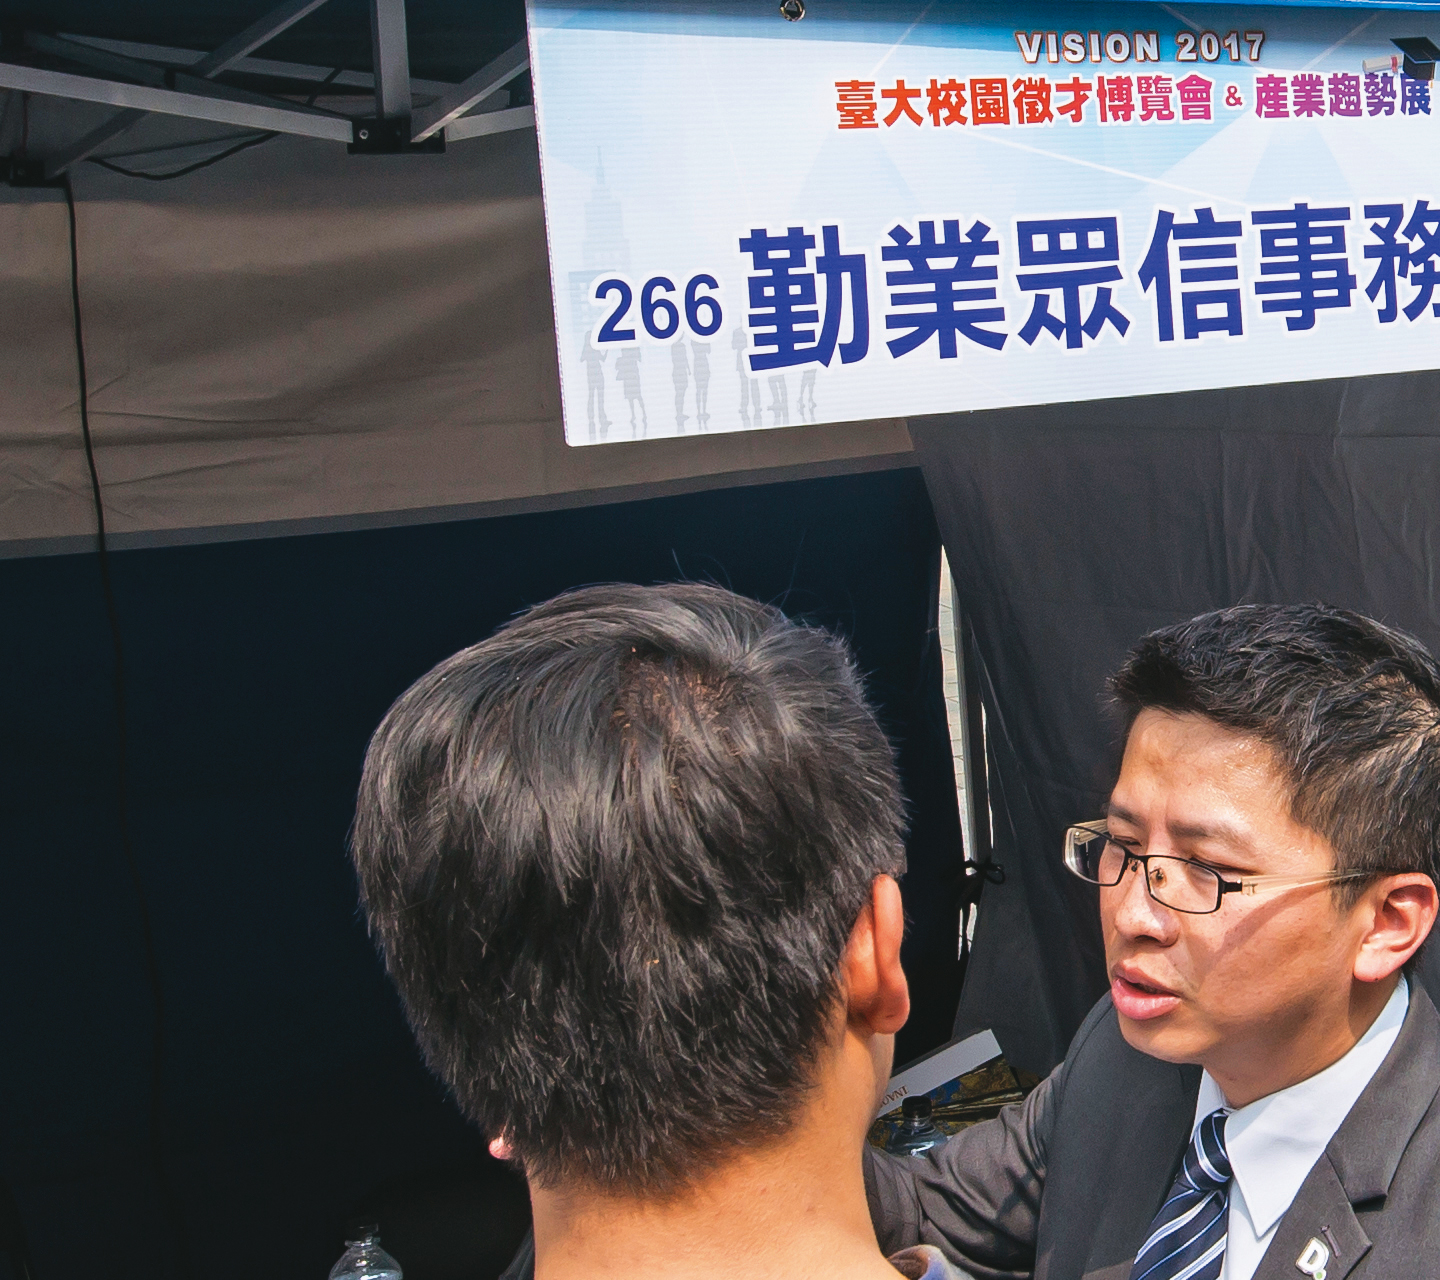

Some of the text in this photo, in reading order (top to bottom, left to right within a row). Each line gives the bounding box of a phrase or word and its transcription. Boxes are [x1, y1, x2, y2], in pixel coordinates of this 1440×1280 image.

[1014, 29, 1267, 65] VISION 2017
[593, 272, 724, 345] 266
